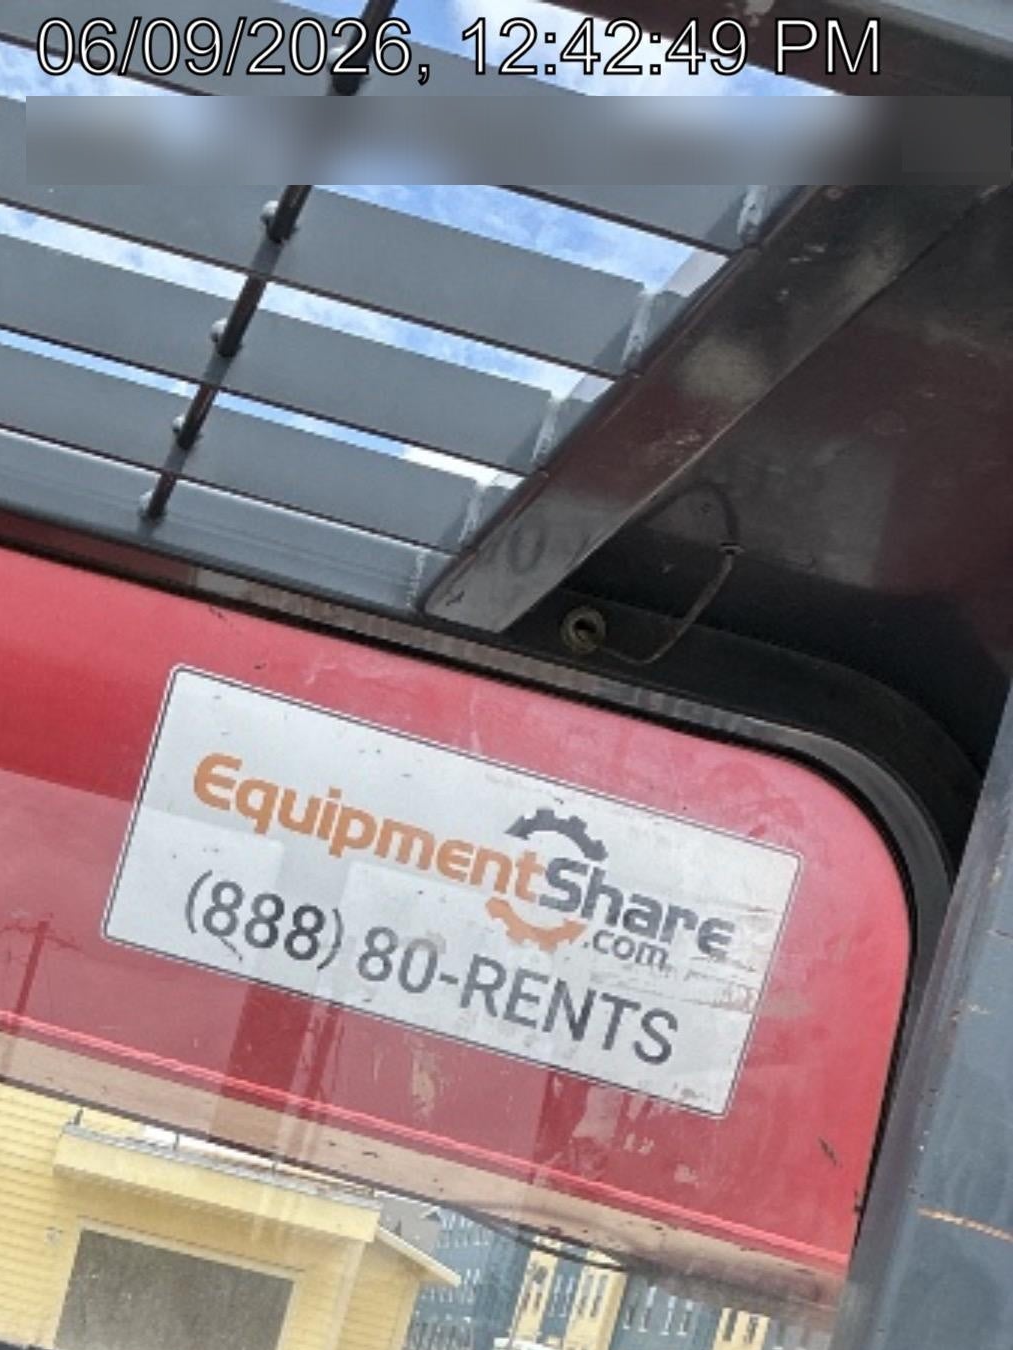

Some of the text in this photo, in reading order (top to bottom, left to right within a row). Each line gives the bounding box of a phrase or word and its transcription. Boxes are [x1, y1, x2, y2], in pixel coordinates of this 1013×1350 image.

[193, 752, 735, 960] EquipmentShare
[184, 869, 678, 1066] (888) 80-RENTS
